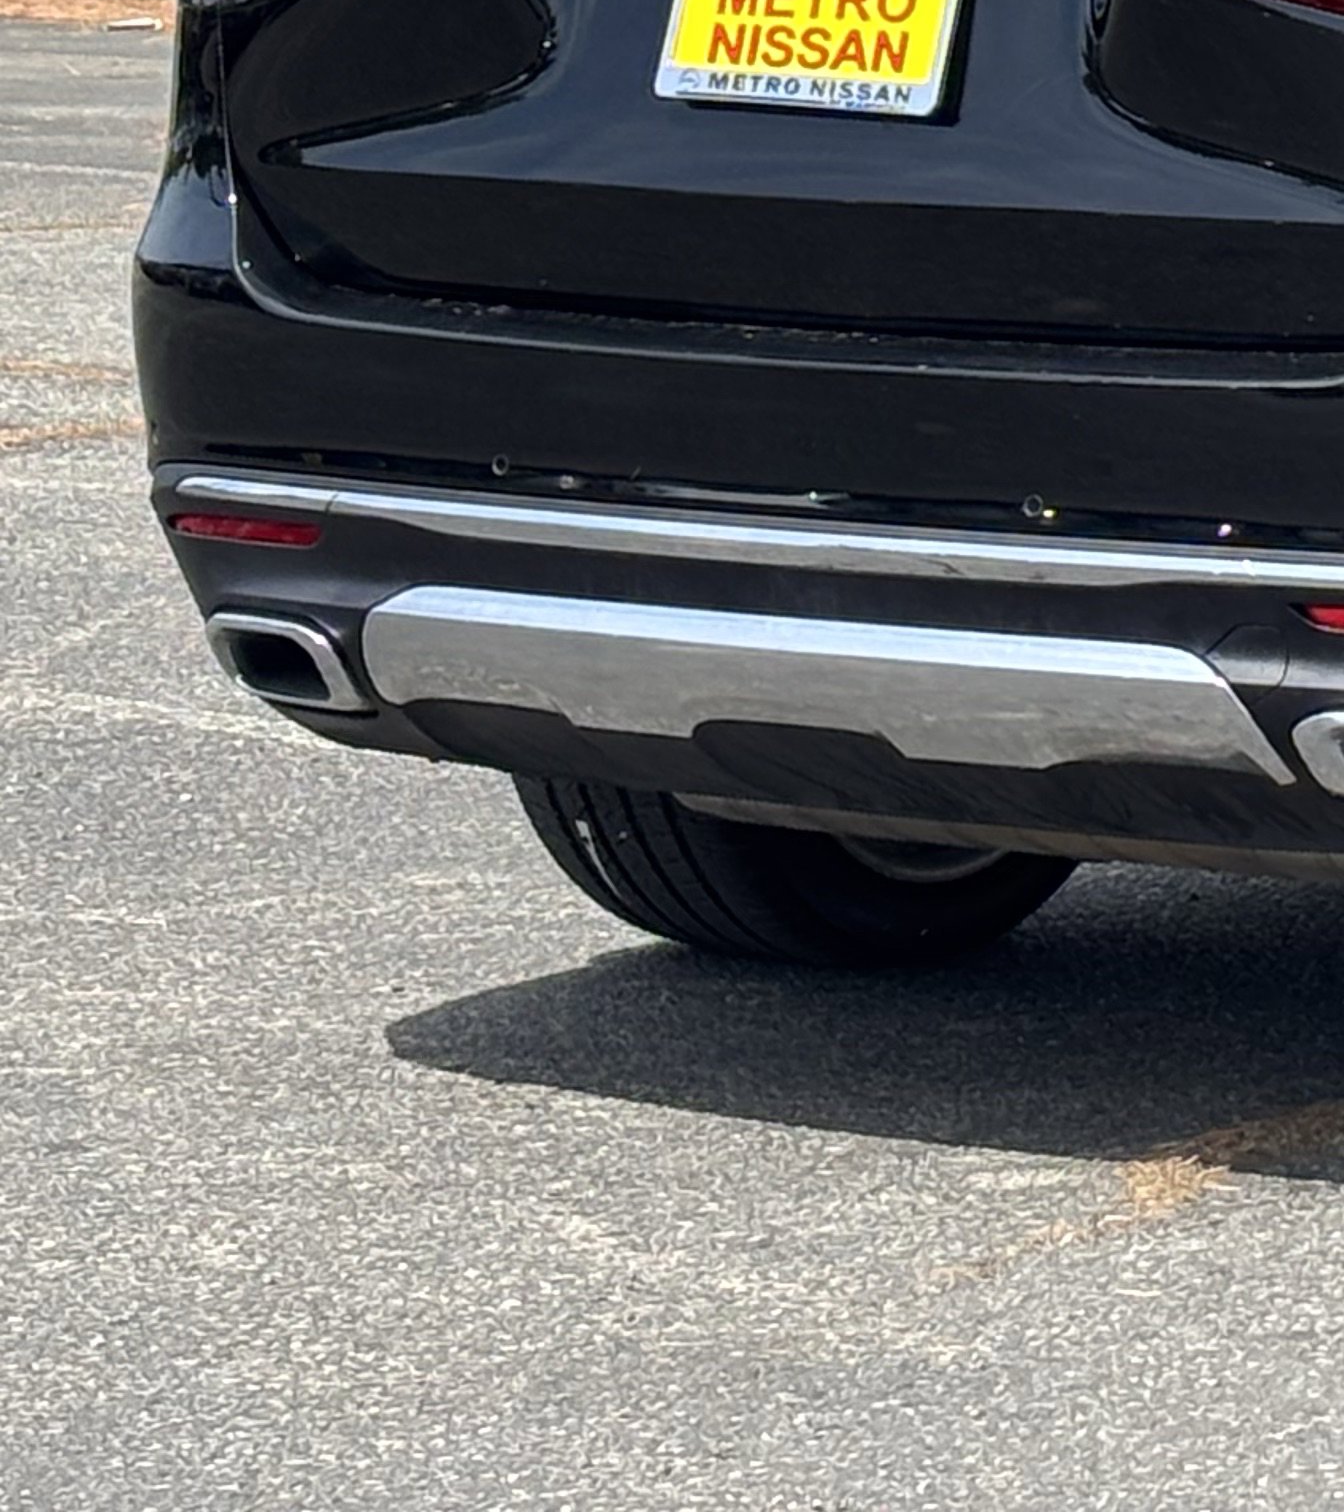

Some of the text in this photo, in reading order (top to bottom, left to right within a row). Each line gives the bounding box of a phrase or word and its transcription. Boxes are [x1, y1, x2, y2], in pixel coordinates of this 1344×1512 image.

[707, 23, 910, 73] NISSAN
[707, 72, 912, 103] METRO NISSAN
